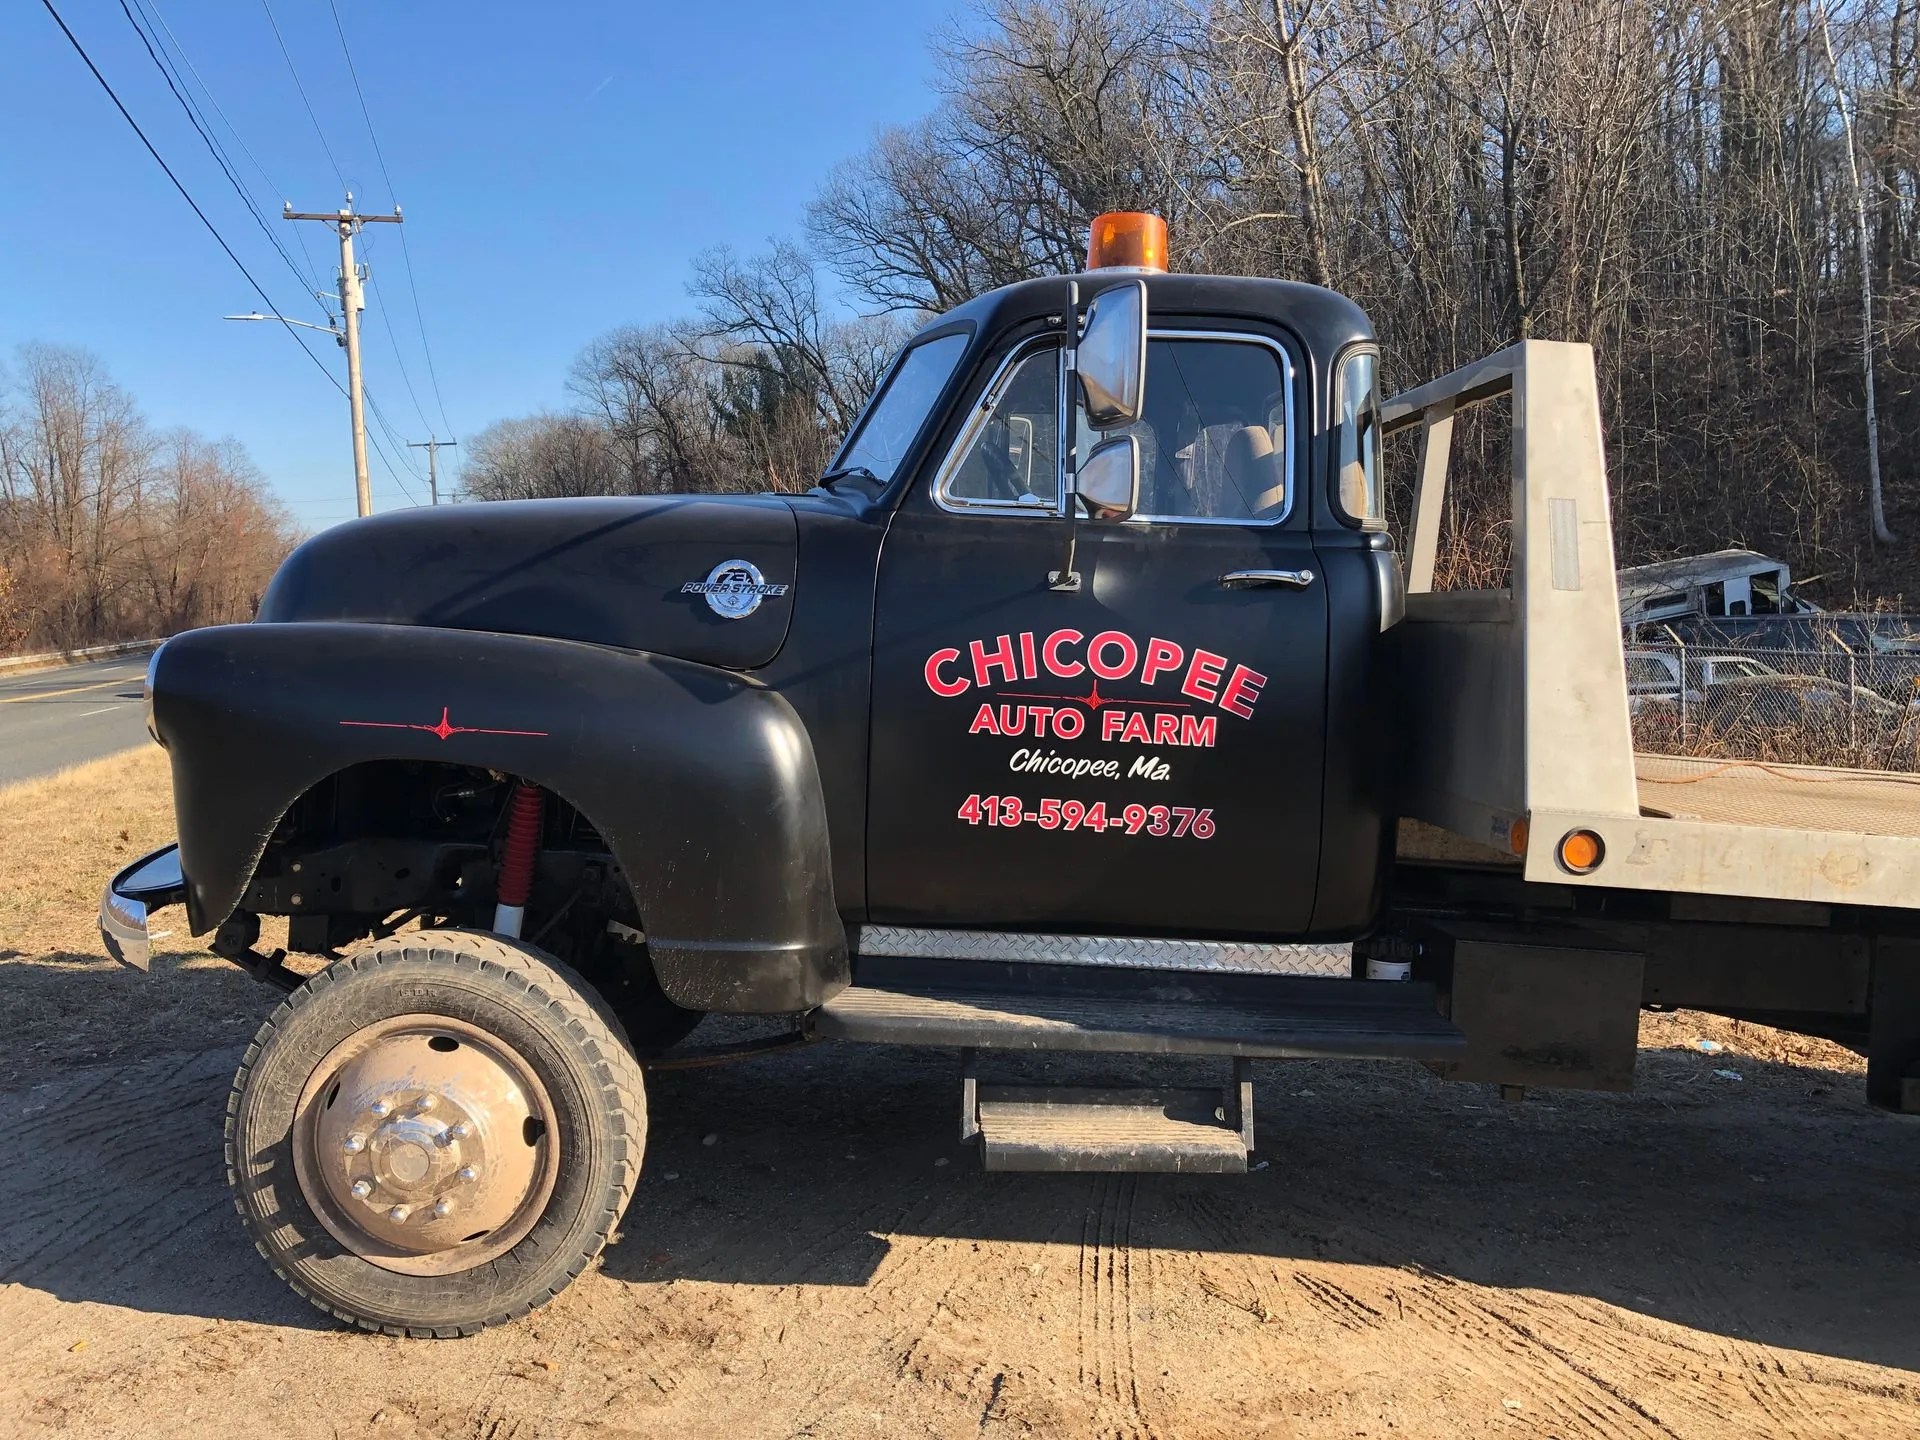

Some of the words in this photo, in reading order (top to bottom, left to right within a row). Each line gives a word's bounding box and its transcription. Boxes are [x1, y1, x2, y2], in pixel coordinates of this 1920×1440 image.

[682, 582, 730, 594] POWER
[731, 583, 786, 595] STROKE
[924, 629, 1267, 720] CHICOPEE
[968, 704, 1085, 740] AUTO
[1101, 710, 1217, 747] FARM
[1009, 748, 1121, 780] Chicopee,
[1127, 755, 1170, 781] Ma.
[958, 794, 1216, 839] 413-594-9376
